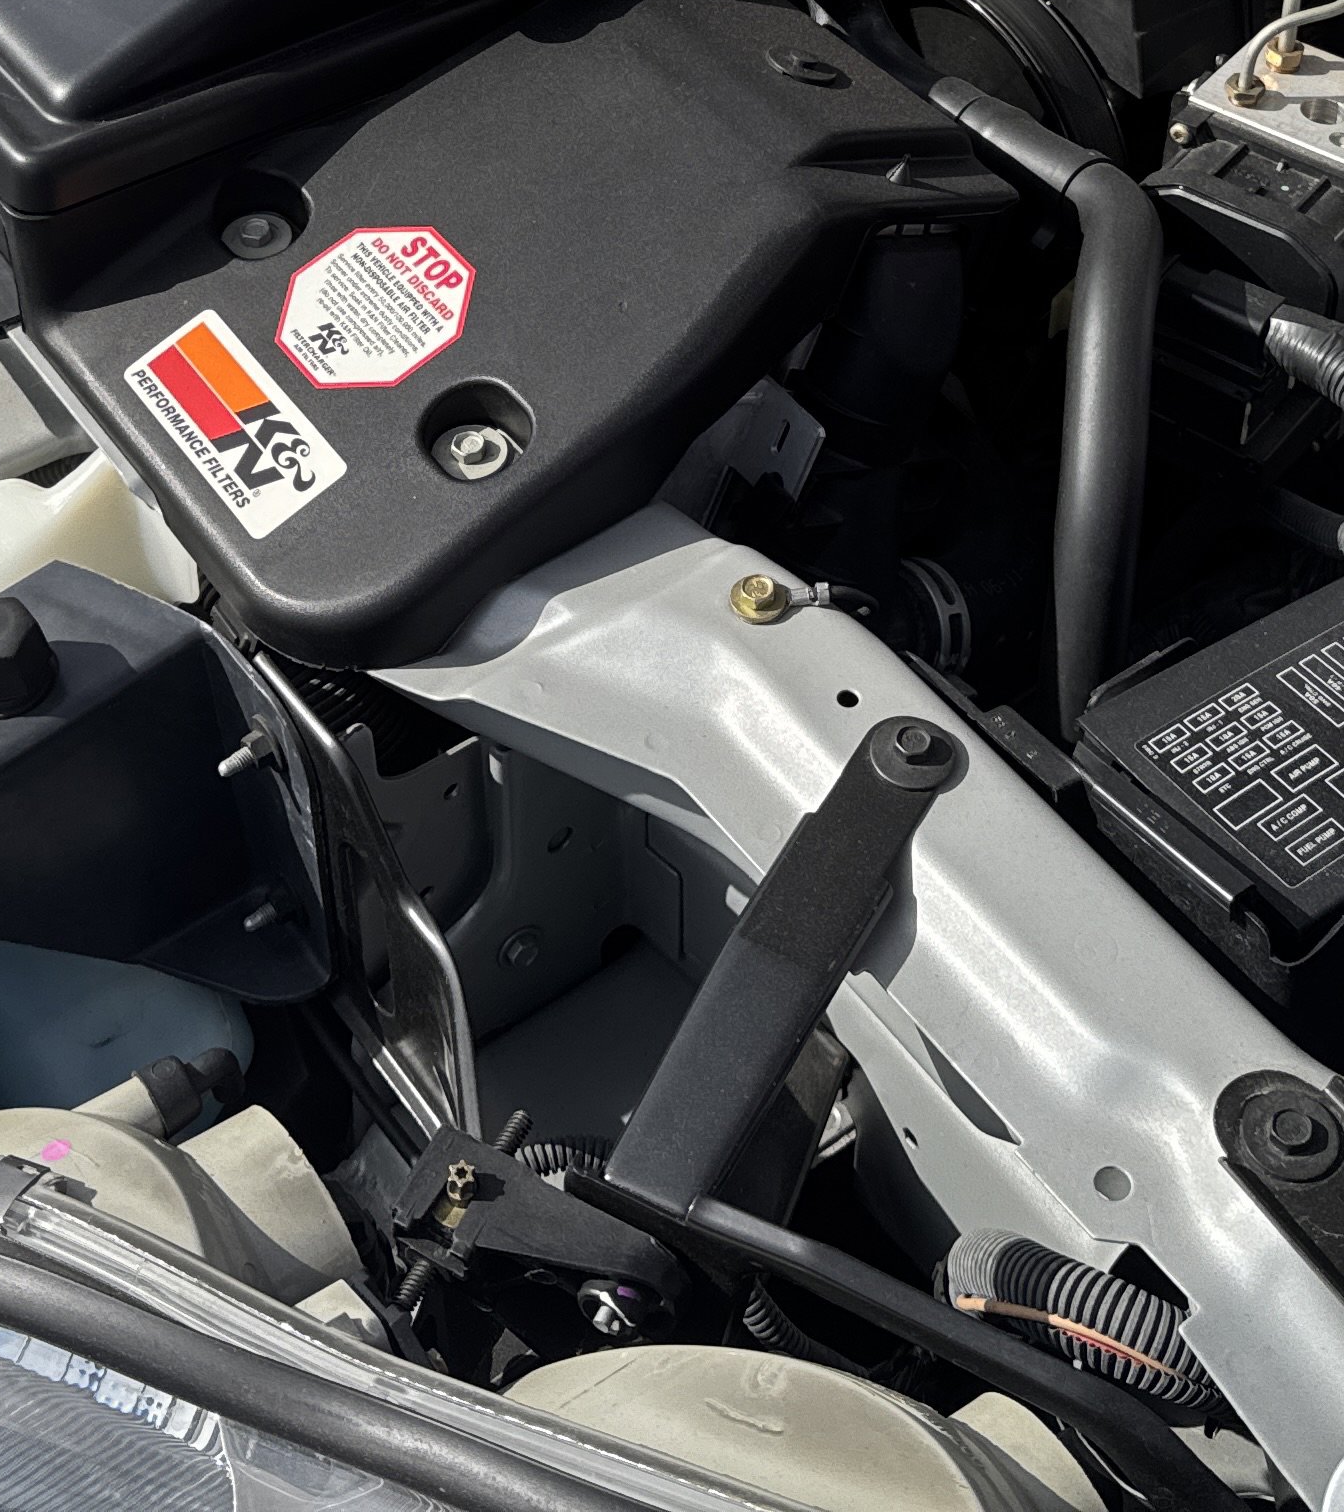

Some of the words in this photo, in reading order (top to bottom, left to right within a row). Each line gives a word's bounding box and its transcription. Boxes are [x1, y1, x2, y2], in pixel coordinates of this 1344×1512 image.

[350, 252, 401, 302] NON-DISPOSABLE
[407, 311, 431, 334] FILTER
[368, 255, 396, 282] VEHICLE
[392, 279, 424, 311] EQUIPPED
[385, 251, 412, 276] NOT
[406, 273, 456, 321] DISCARD
[400, 236, 464, 291] STOP
[130, 367, 211, 460] PERFORMANCE
[202, 454, 251, 510] FILTERS
